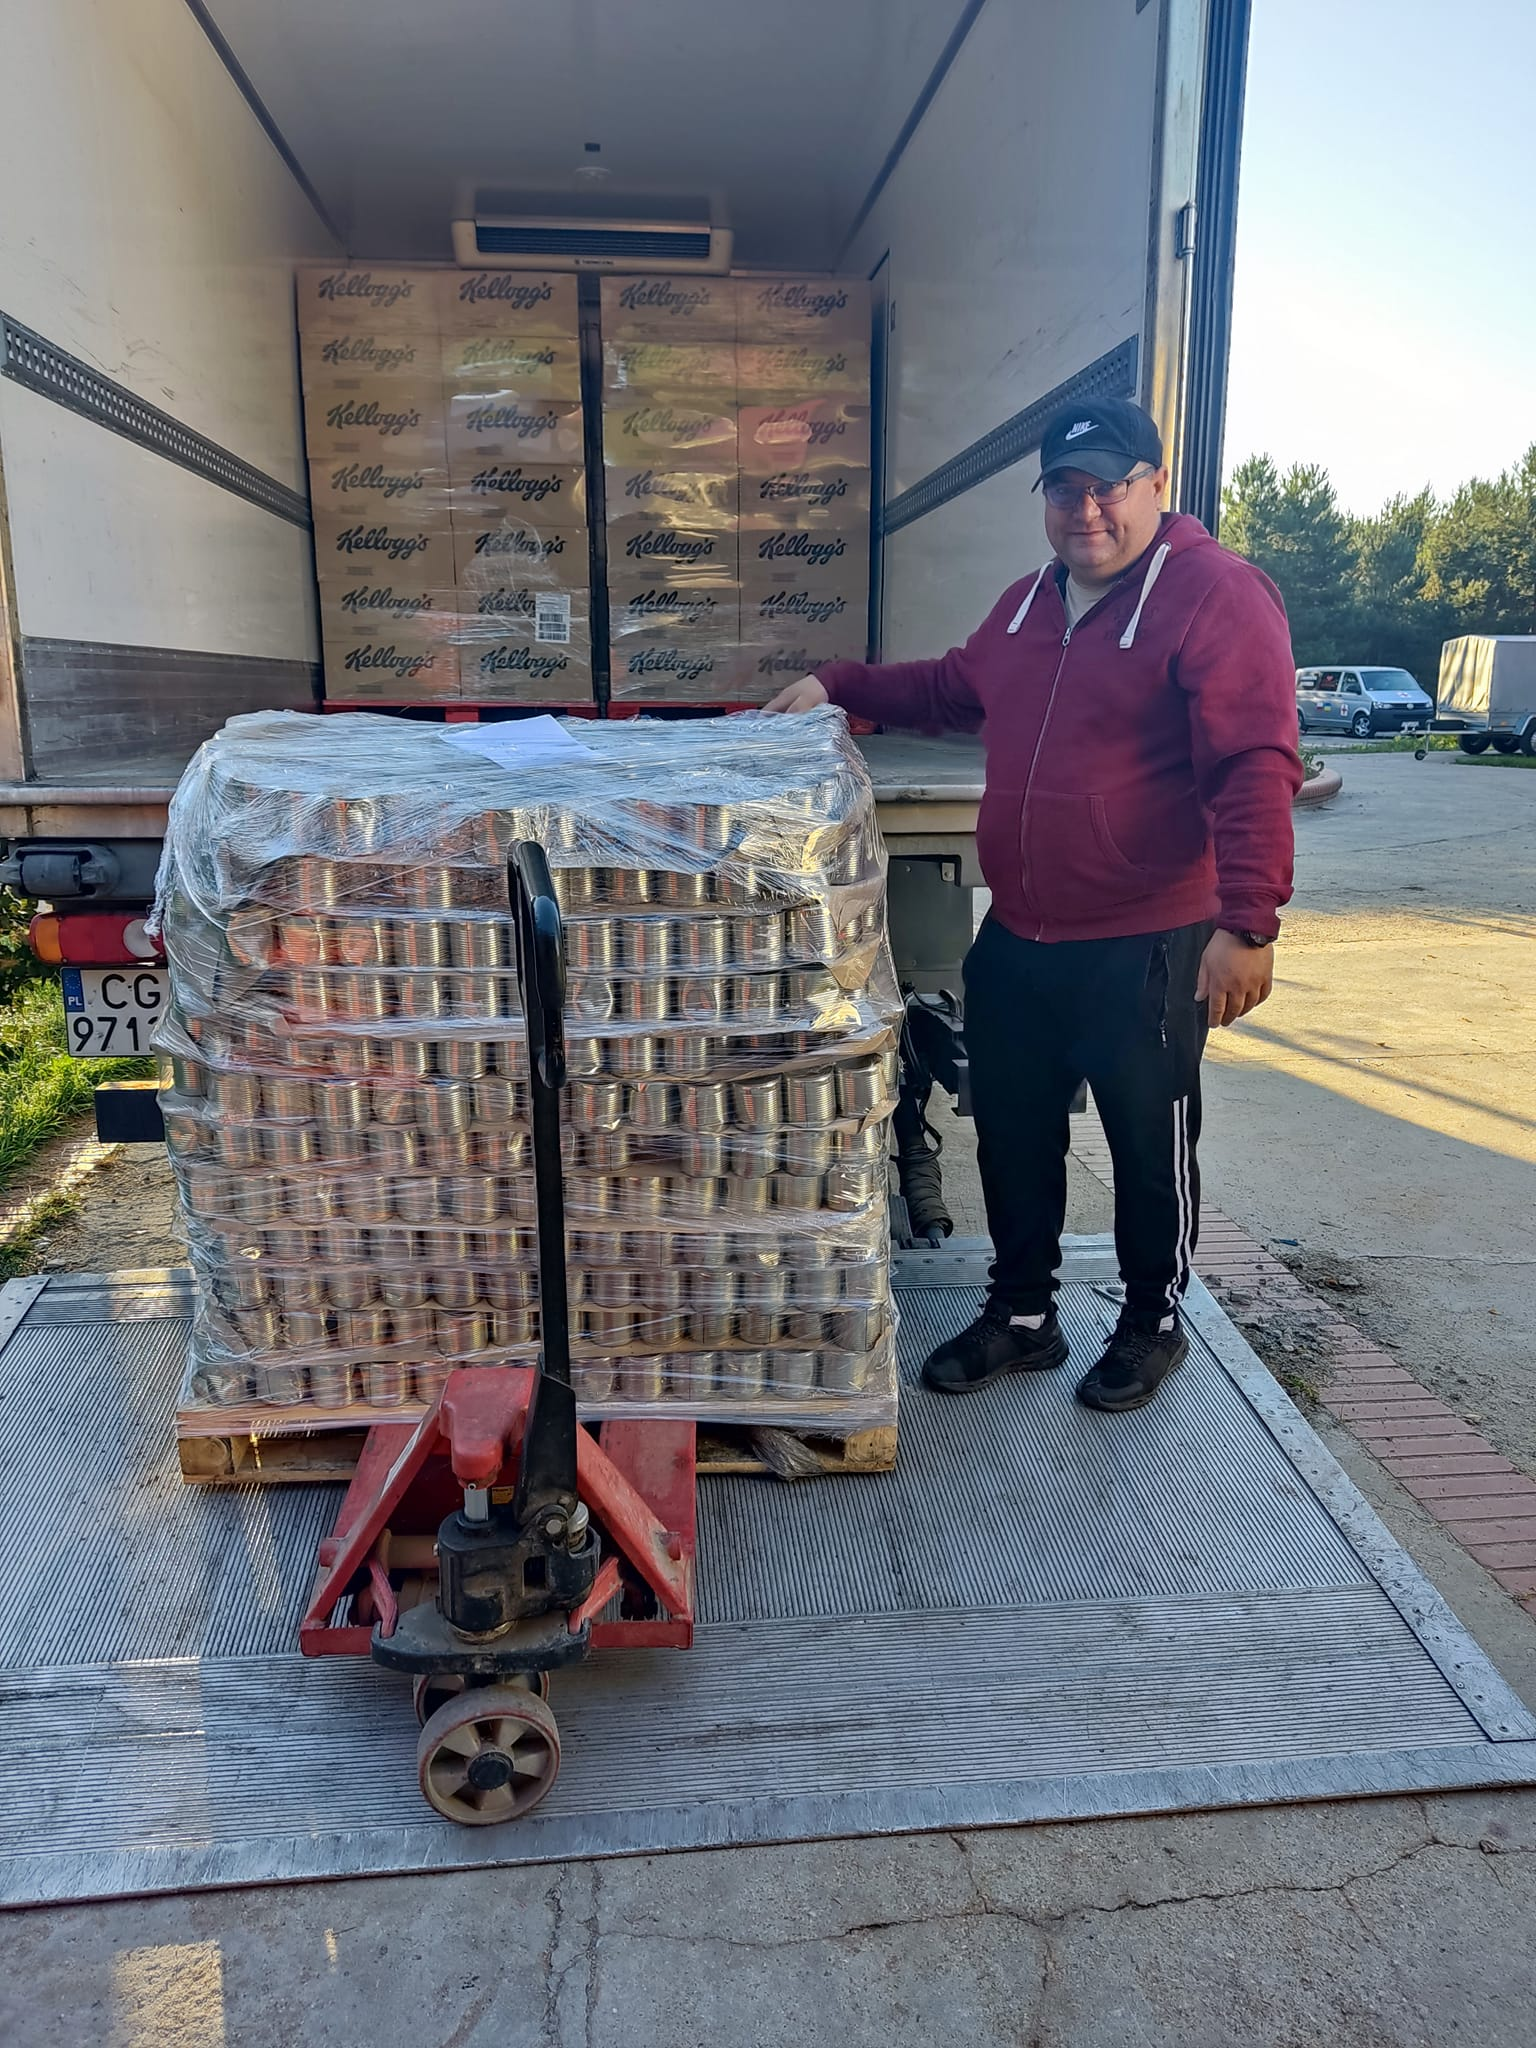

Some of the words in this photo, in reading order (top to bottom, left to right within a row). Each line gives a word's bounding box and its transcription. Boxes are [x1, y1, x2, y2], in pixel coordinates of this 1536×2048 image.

[319, 270, 414, 307] Kellogg's
[459, 273, 552, 309] Kellogg's
[620, 280, 711, 315] Kellogg's
[322, 336, 416, 371] Kellogg's
[326, 400, 421, 435] Kellogg's
[467, 403, 559, 438] Kellogg's
[622, 408, 714, 441] Kellogg's
[1071, 420, 1092, 433] NIKE
[331, 463, 424, 497] Kellogg's
[471, 467, 563, 501] Kellogg's
[336, 525, 430, 560] Kellogg's
[626, 530, 716, 564] Kellogg's
[758, 532, 848, 565] Kellogg's
[341, 586, 434, 619] Kellogg's
[759, 591, 848, 623] Kellogg's
[345, 644, 437, 677] Kellogg's
[480, 646, 570, 678] Kellogg's
[628, 648, 714, 679] Kellogg's
[67, 996, 83, 1006] PL
[101, 973, 161, 1009] CG
[73, 1016, 159, 1052] 971
